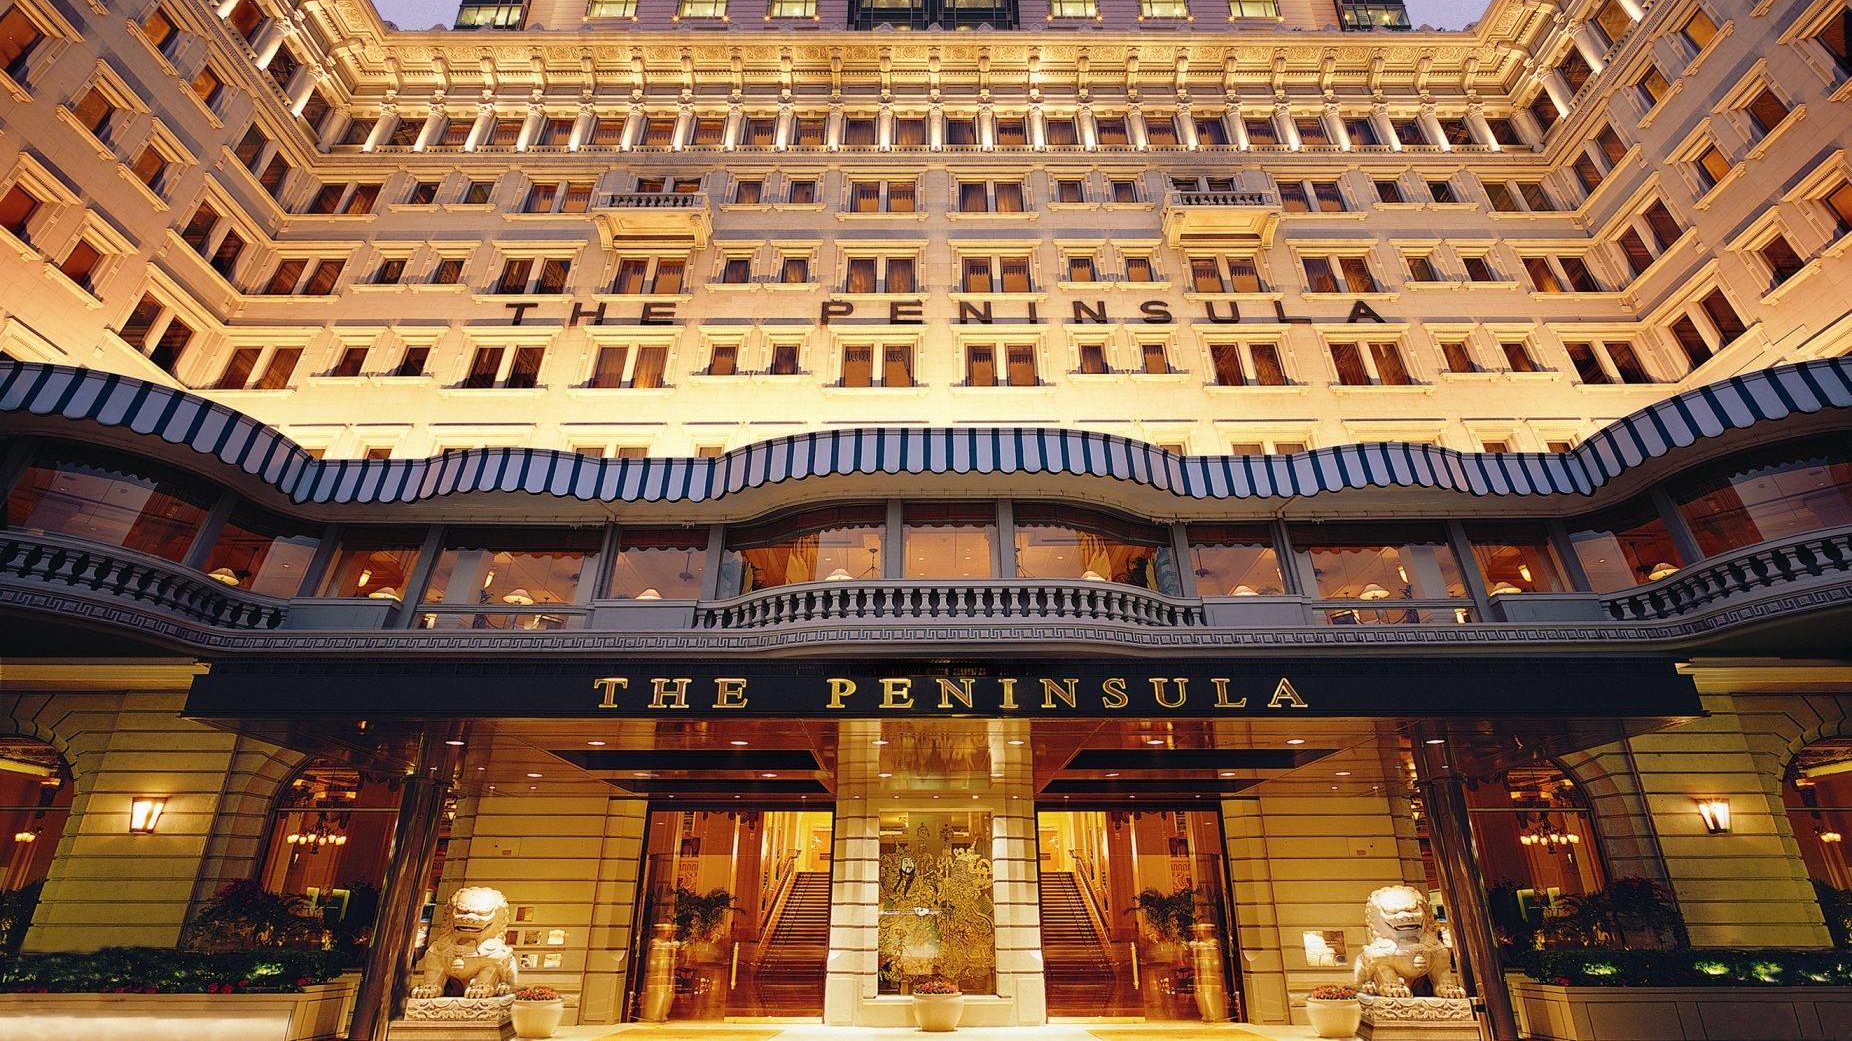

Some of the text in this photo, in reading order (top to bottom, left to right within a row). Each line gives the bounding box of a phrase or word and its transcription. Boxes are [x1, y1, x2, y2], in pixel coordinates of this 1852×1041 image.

[505, 300, 1387, 326] THE PENINSULA
[593, 677, 1309, 709] THE PENINSULA
